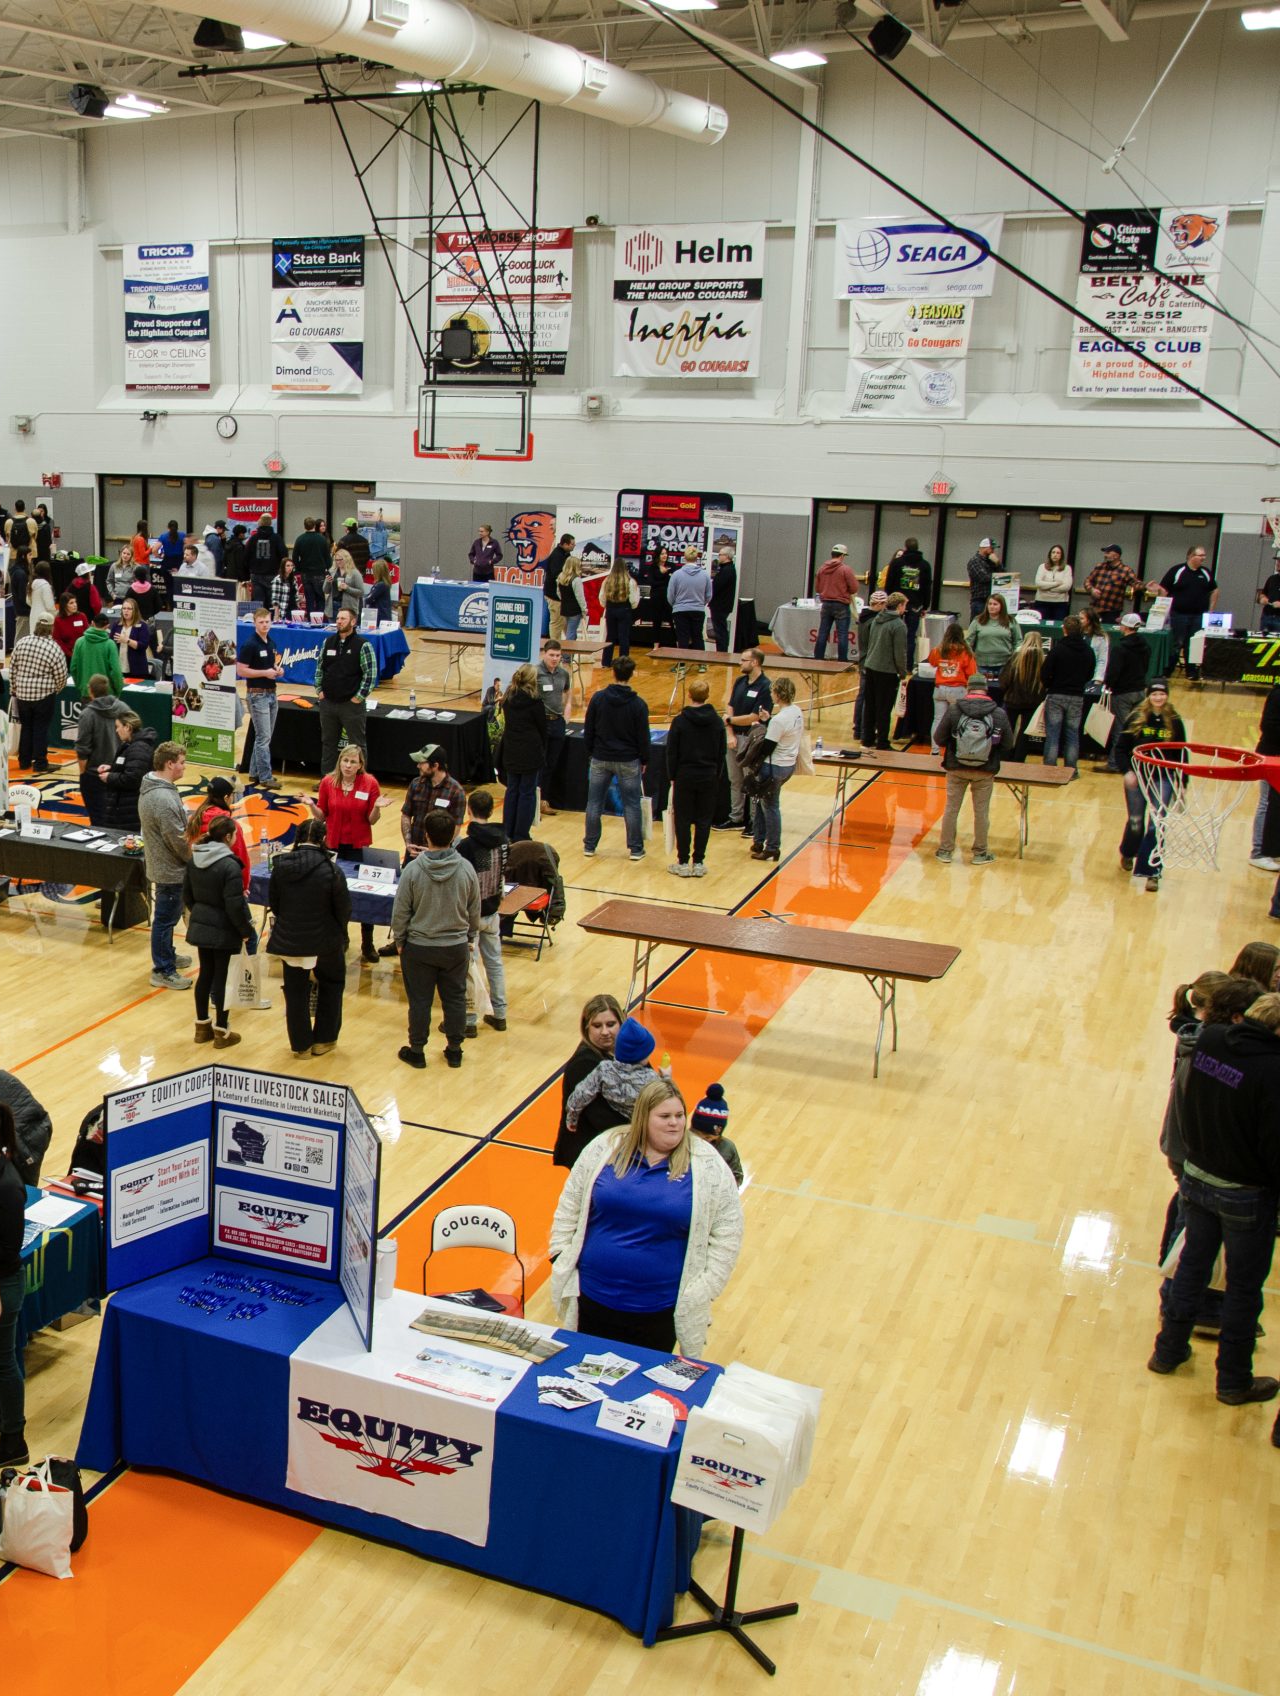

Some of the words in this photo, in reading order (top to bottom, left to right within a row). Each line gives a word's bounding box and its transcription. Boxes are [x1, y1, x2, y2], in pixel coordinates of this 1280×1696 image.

[1117, 224, 1150, 234] Citizens
[1118, 234, 1140, 244] State
[142, 248, 184, 257] TRICOR
[676, 238, 753, 264] Helm
[896, 244, 967, 262] SEAGA
[293, 253, 326, 265] State
[328, 252, 361, 264] Bank
[509, 260, 532, 270] GOOD
[534, 260, 556, 269] LUCK
[694, 281, 744, 290] SUPPORTS
[946, 284, 983, 292] seaga.com
[648, 292, 694, 300] HIGHLAND
[698, 291, 748, 299] COUGARS!
[1120, 286, 1170, 308] Café
[908, 306, 915, 318] 4
[917, 304, 964, 319] SEASONS
[1106, 312, 1182, 320] 232-5512
[134, 320, 154, 328] Proud
[156, 319, 191, 330] Supporter
[193, 318, 201, 326] of
[628, 307, 747, 342] Inertia
[140, 329, 174, 338] Highland
[174, 328, 207, 338] Cougars!
[290, 328, 300, 336] GO
[302, 328, 344, 336] COUGARS!
[908, 338, 920, 348] Go
[922, 338, 962, 348] Cougars!
[1154, 341, 1202, 353] CLUB
[276, 366, 312, 376] Dimond
[313, 366, 335, 376] Bros.
[680, 360, 696, 372] GO
[698, 360, 749, 372] COUGARS!
[1092, 370, 1134, 380] Highland
[932, 482, 951, 496] EXIT
[232, 503, 274, 514] Eastland
[622, 522, 639, 531] GO
[646, 541, 657, 550] &
[496, 602, 514, 612] CHANNEL
[514, 603, 526, 613] FIELD
[476, 617, 482, 625] &
[495, 614, 508, 623] CHECK
[508, 614, 514, 624] UP
[514, 615, 528, 624] SERIES
[1242, 674, 1274, 684] AGRISOAR
[371, 871, 382, 880] 37
[114, 1090, 146, 1106] EQUITY
[152, 1080, 182, 1104] EQUITY
[254, 1078, 309, 1102] LIVESTOCK
[312, 1088, 344, 1108] SALES
[222, 1090, 242, 1102] Century
[251, 1096, 279, 1108] Excellence
[280, 1101, 286, 1109] in
[286, 1102, 312, 1114] Livestock
[314, 1106, 342, 1120] Marketing
[126, 1112, 136, 1120] 100
[158, 1165, 171, 1176] Start
[172, 1162, 182, 1173] Your
[184, 1156, 200, 1169] Career
[120, 1174, 154, 1192] EQUITY
[158, 1174, 178, 1188] Journey
[179, 1170, 190, 1182] With
[192, 1166, 200, 1178] Us!
[160, 1198, 174, 1206] Finance
[160, 1202, 181, 1215] Information
[181, 1196, 200, 1209] Technology
[122, 1210, 135, 1220] Market
[136, 1204, 154, 1216] Operations
[238, 1200, 310, 1224] EQUITY
[122, 1219, 132, 1228] Field
[133, 1214, 147, 1225] Services
[440, 1214, 509, 1241] COUGARS
[630, 1408, 646, 1417] TABLE
[624, 1416, 646, 1431] 27
[297, 1396, 483, 1469] EQUITY
[690, 1454, 766, 1486] EQUITY
[686, 1482, 700, 1491] Equity
[700, 1486, 725, 1500] Cooperative
[725, 1498, 746, 1508] Livestock
[746, 1504, 760, 1513] Sales
